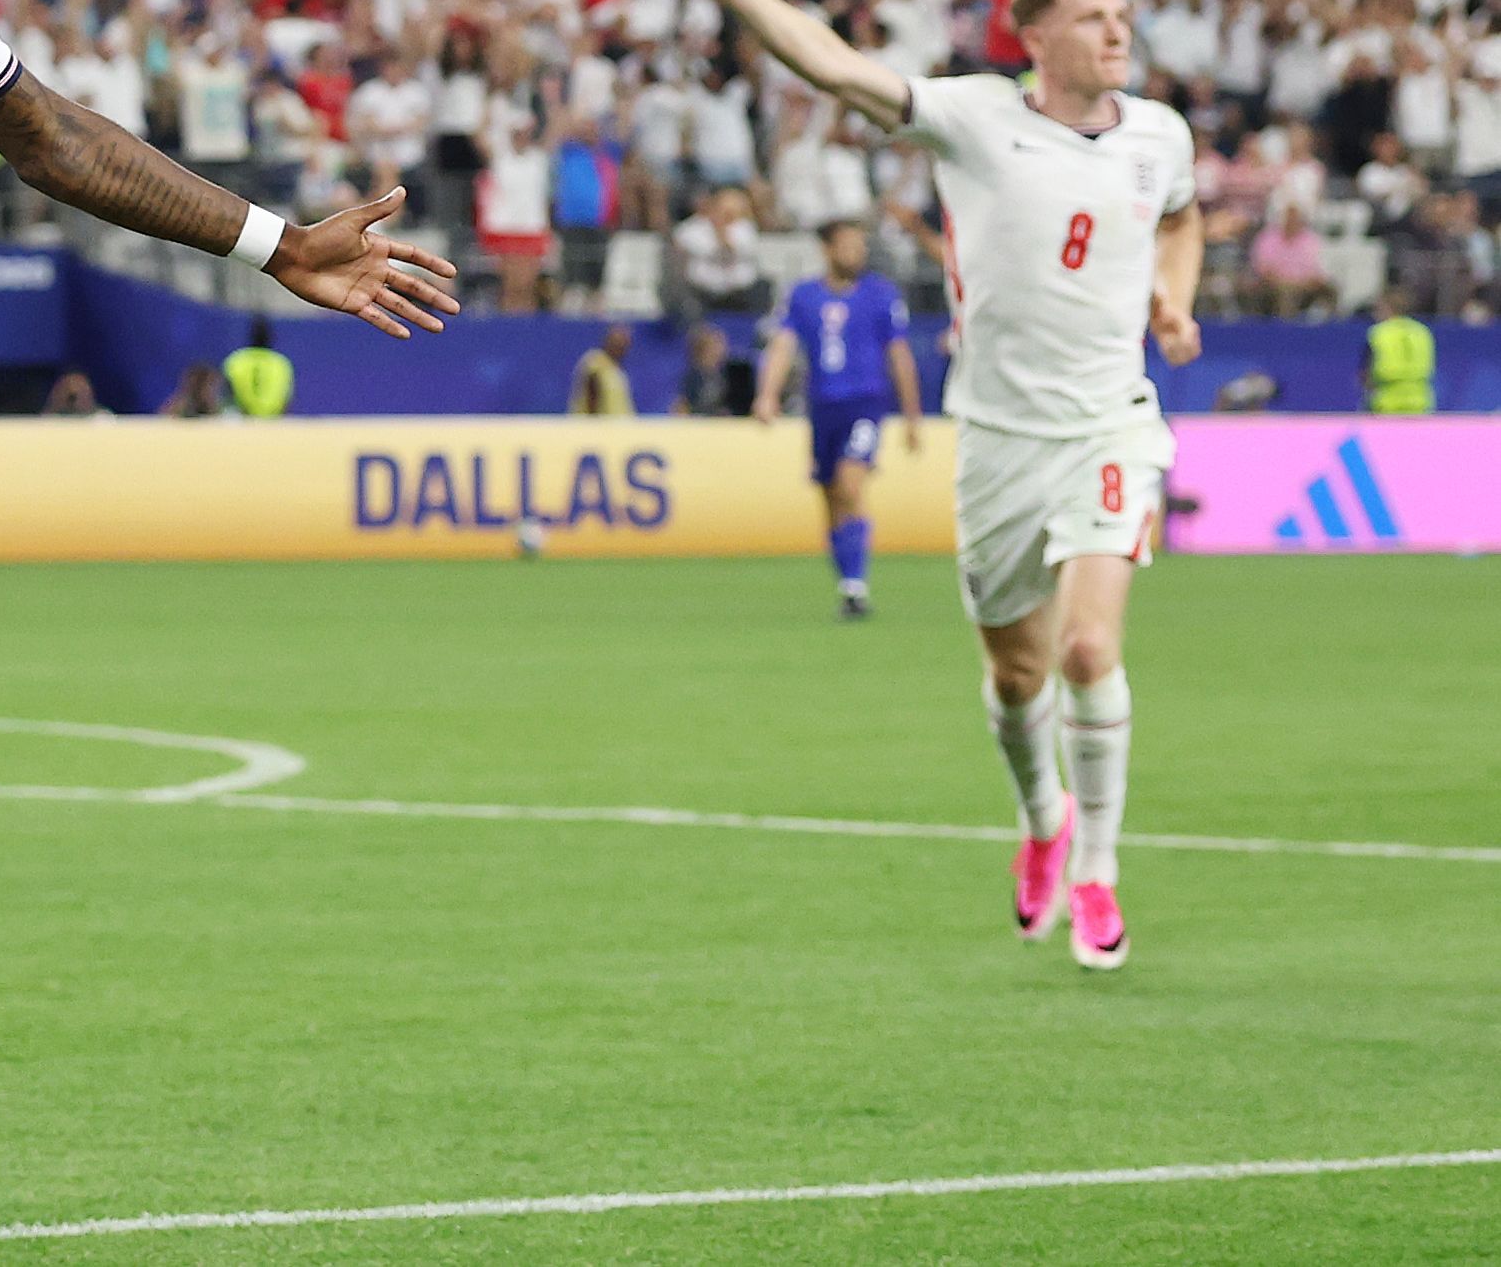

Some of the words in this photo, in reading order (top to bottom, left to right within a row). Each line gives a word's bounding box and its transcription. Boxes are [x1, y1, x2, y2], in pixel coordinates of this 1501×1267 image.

[1061, 212, 1093, 270] 8
[354, 452, 671, 527] DALLAS
[1101, 464, 1122, 512] 8
